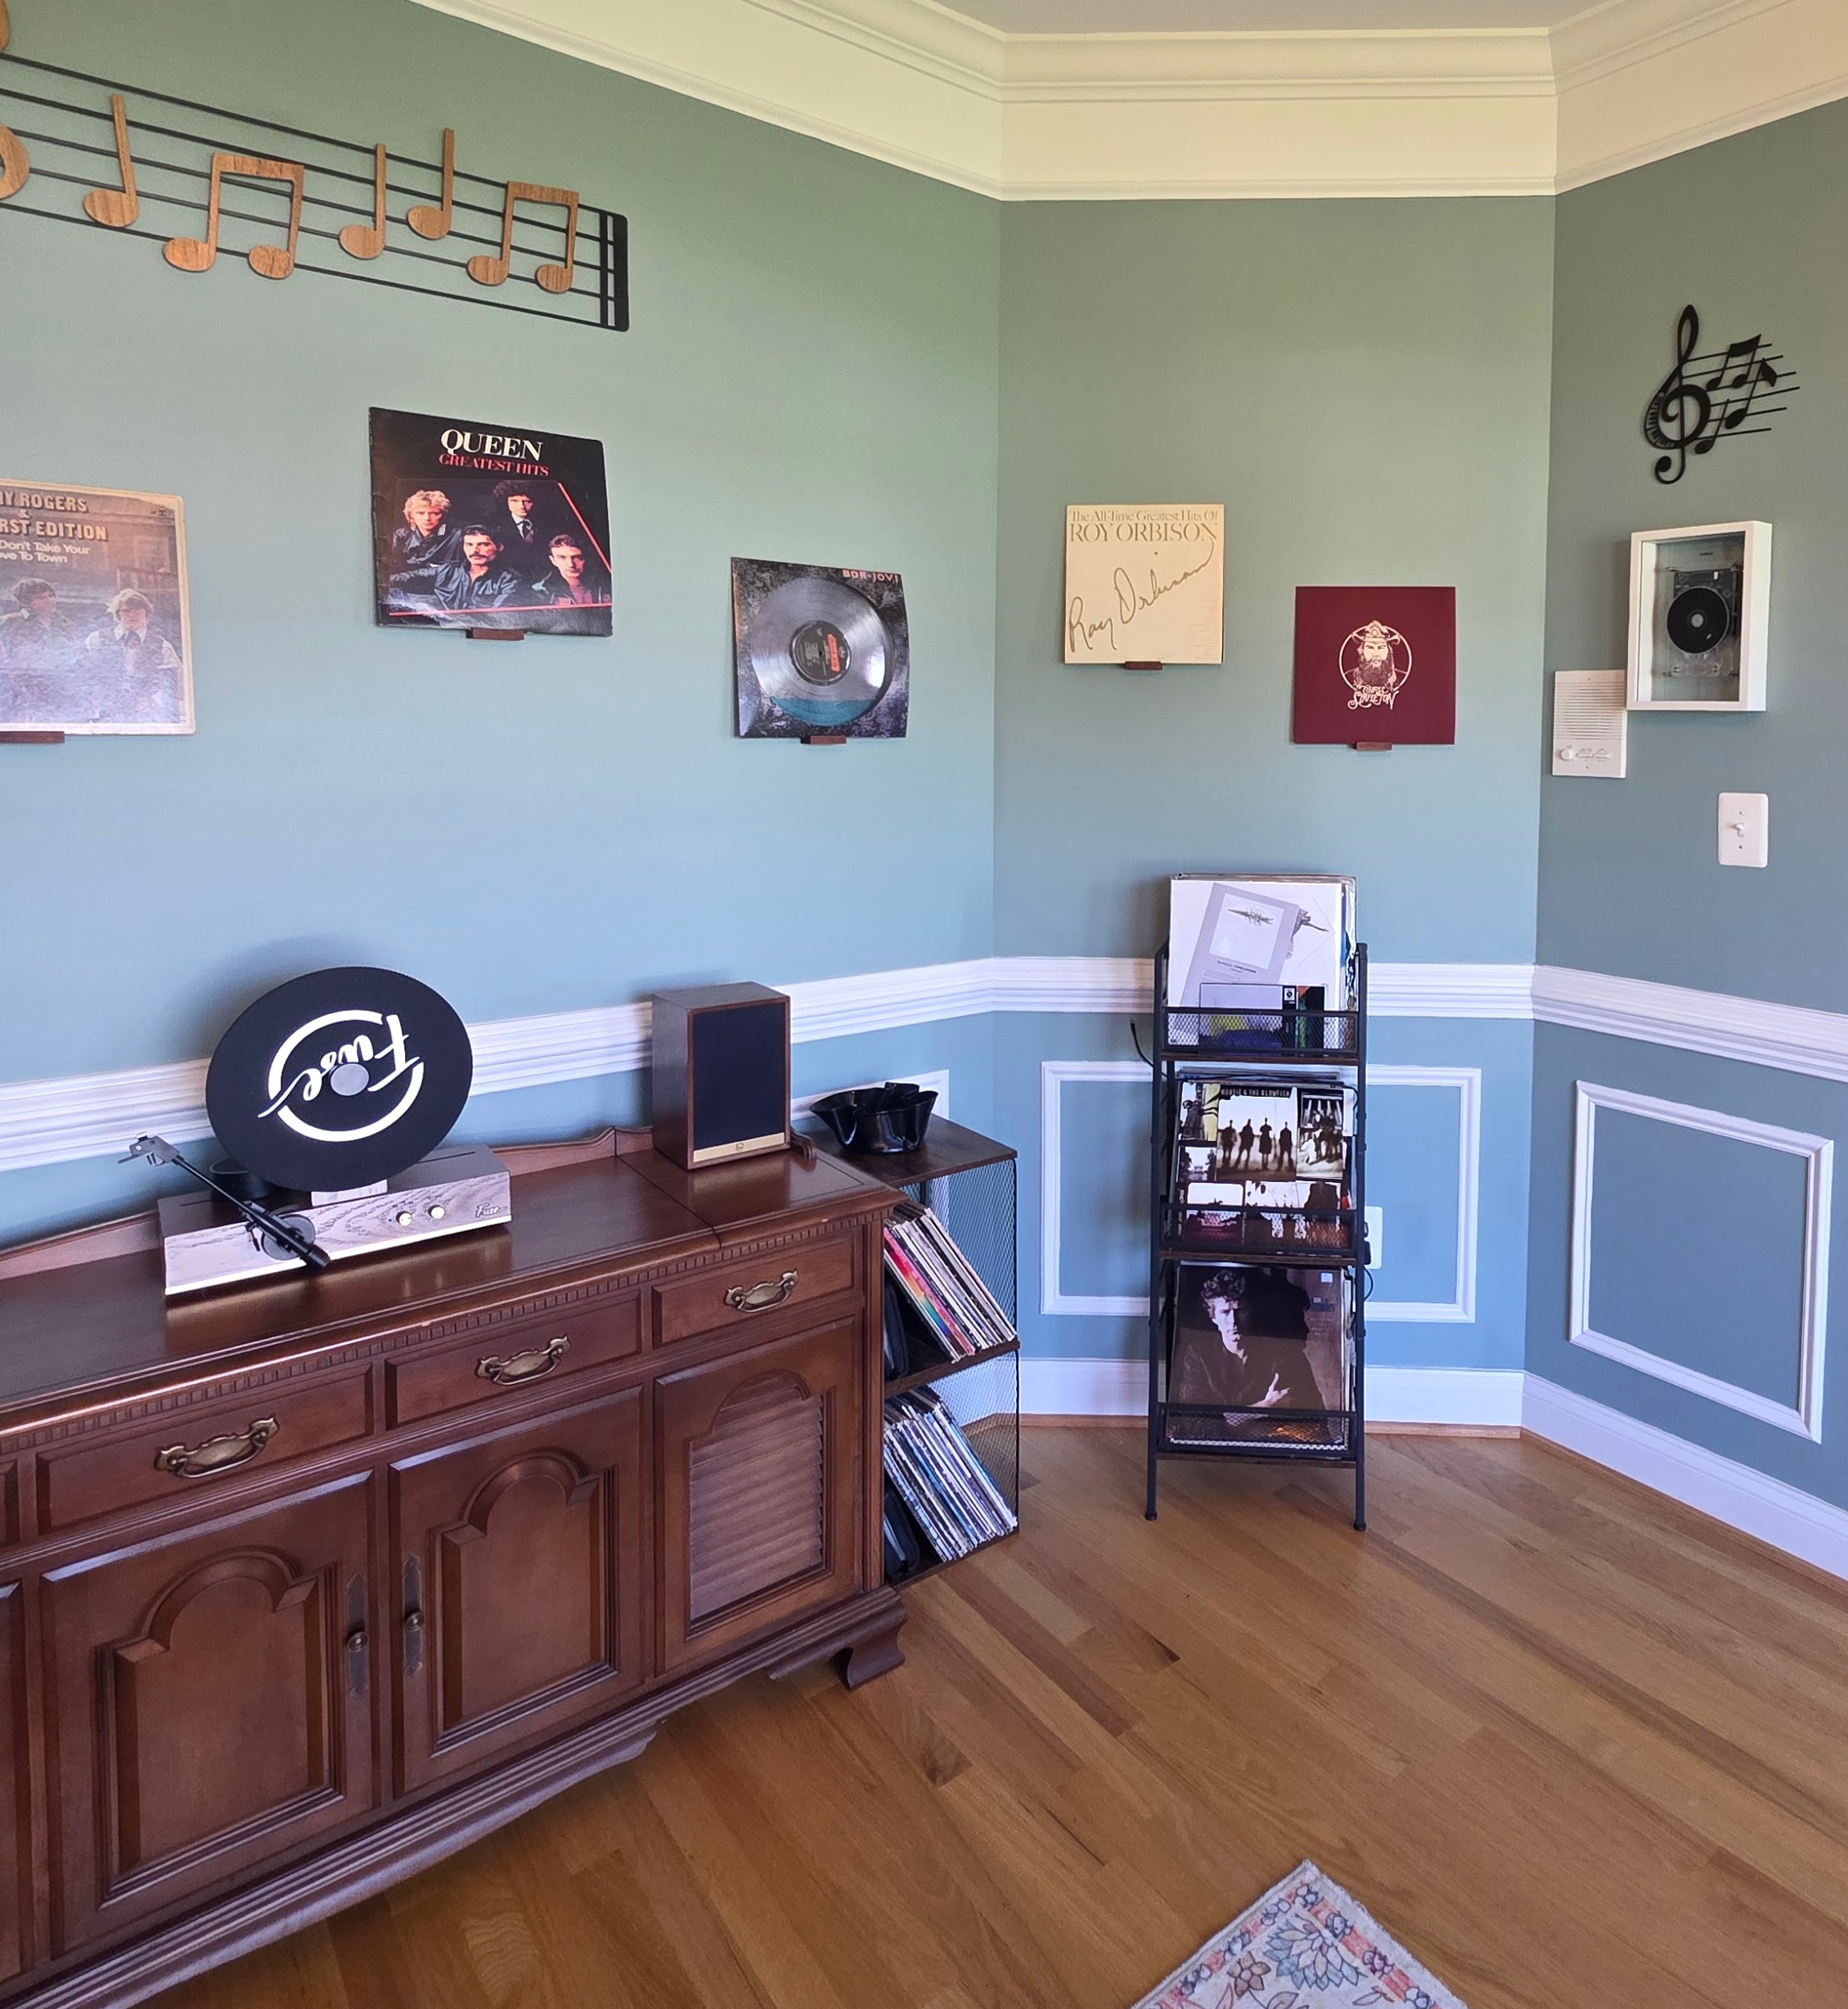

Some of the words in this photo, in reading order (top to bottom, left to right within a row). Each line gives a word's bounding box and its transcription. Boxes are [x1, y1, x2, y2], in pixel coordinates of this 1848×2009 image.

[441, 429, 543, 461] QUEEN
[438, 453, 514, 472] GREATEST
[516, 463, 549, 477] HITS
[20, 492, 88, 512] ROGERS
[18, 509, 30, 519] &
[1136, 510, 1179, 522] Greatest
[1181, 510, 1202, 521] Hits
[1203, 510, 1219, 521] Of
[36, 520, 107, 541] EDITION
[1070, 523, 1113, 542] ROY
[1117, 522, 1218, 542] ORBISON
[18, 551, 34, 561] To
[34, 552, 68, 563] Town
[33, 542, 61, 553] Take
[63, 543, 90, 555] Your
[258, 1014, 420, 1117] Fuse
[475, 1202, 508, 1218] Fuse
